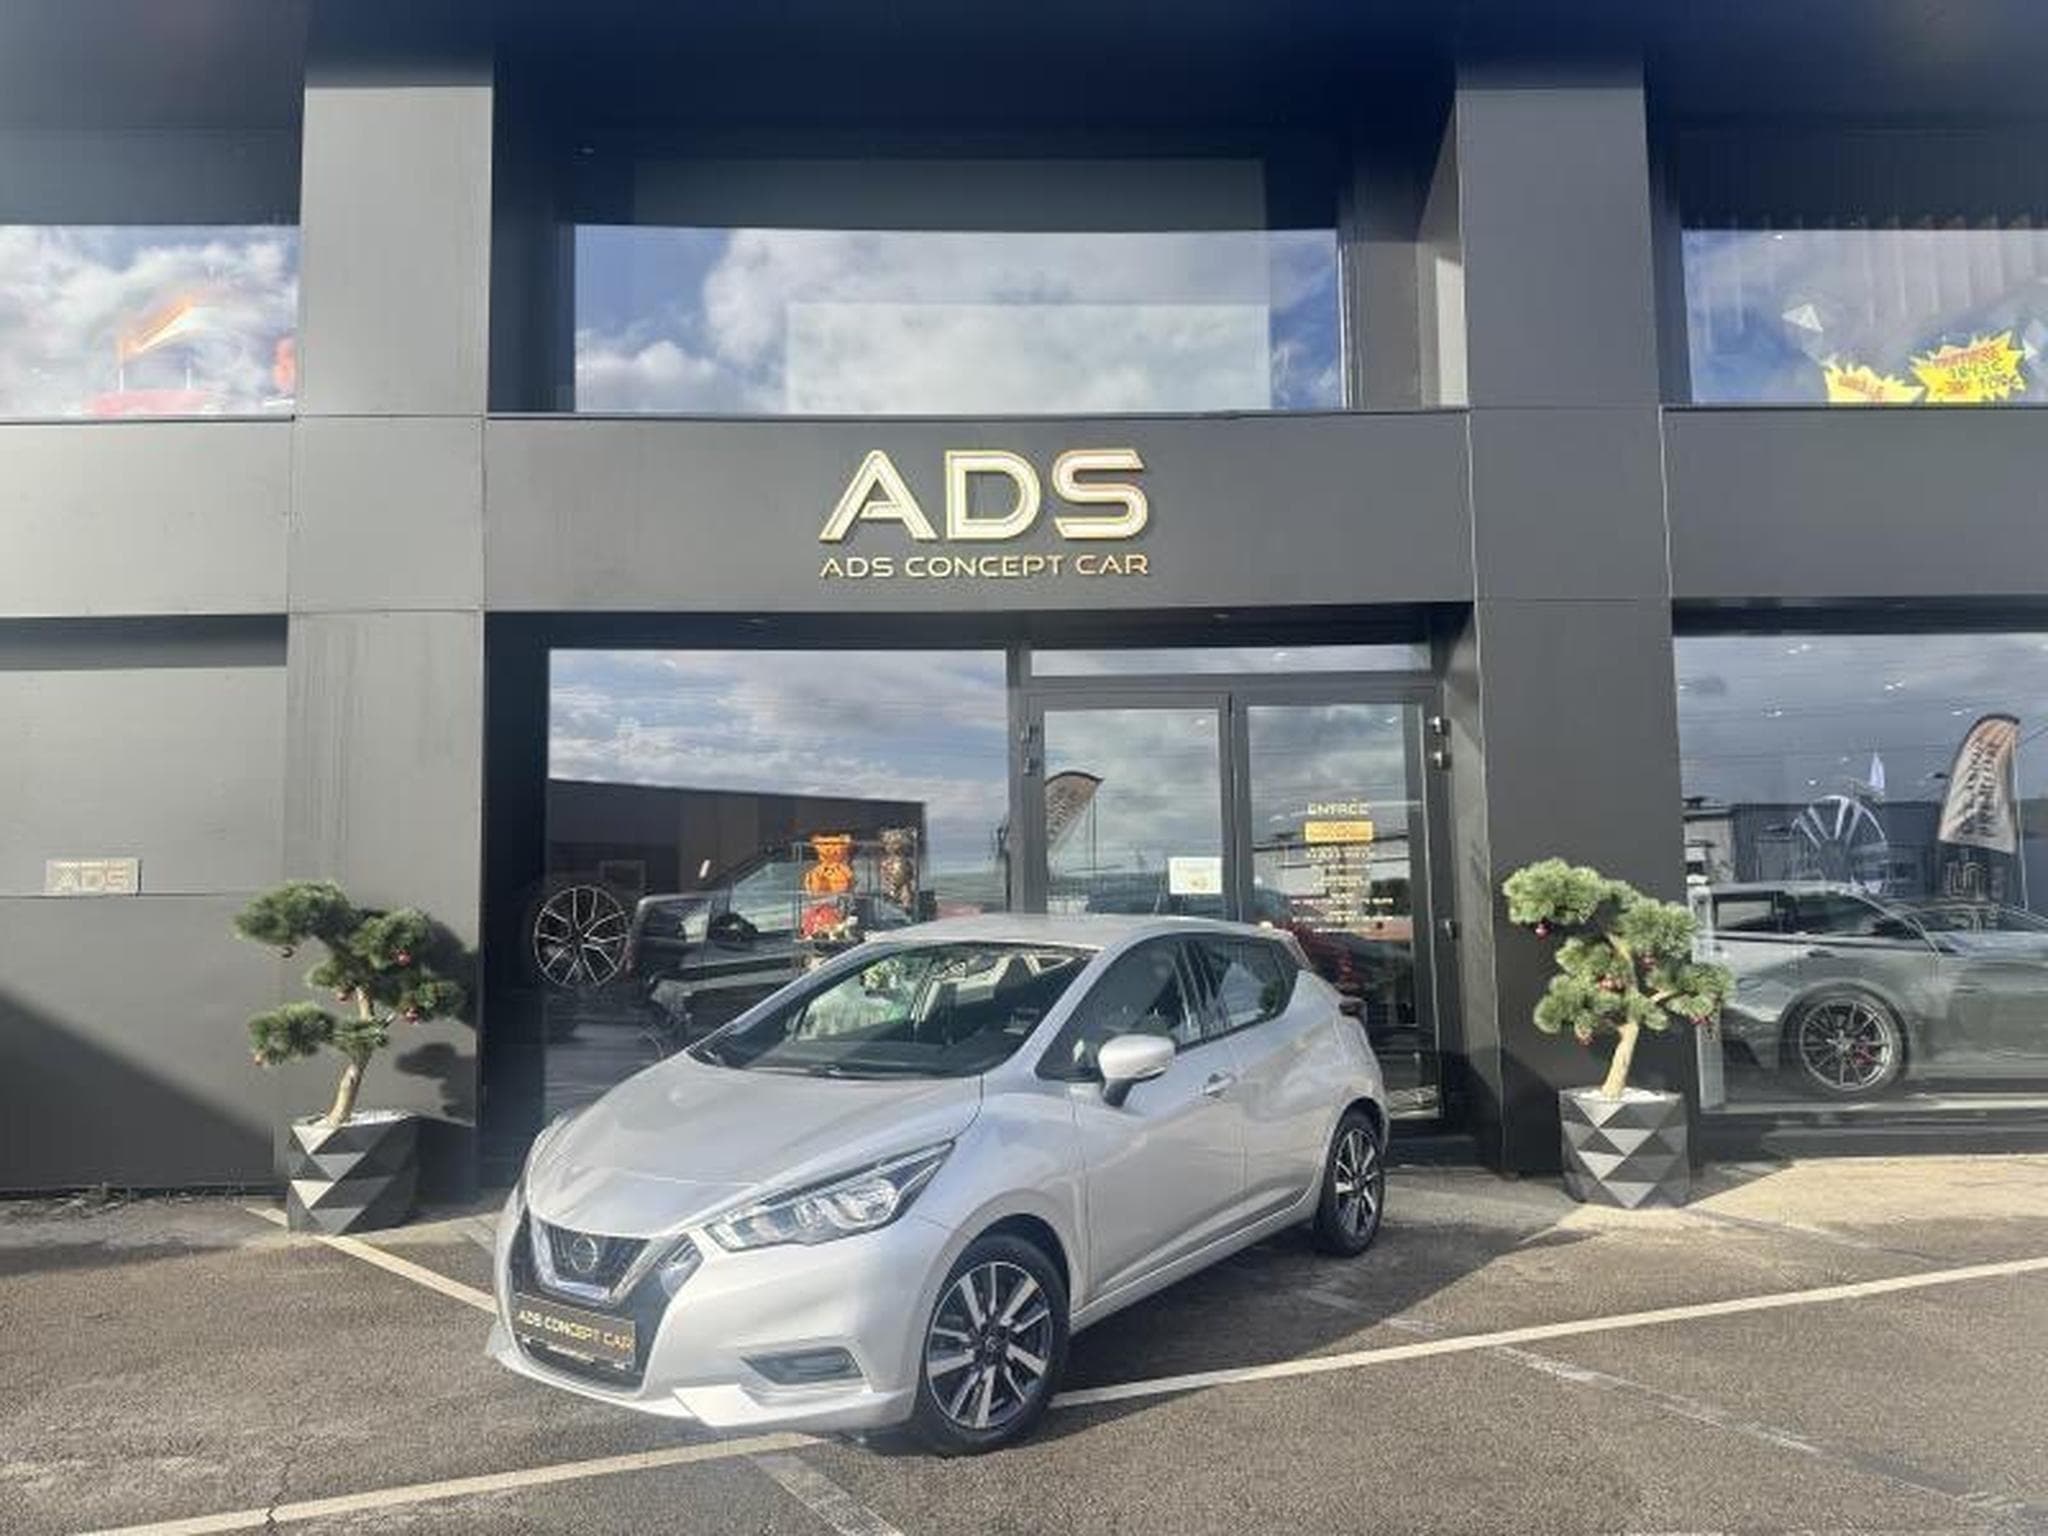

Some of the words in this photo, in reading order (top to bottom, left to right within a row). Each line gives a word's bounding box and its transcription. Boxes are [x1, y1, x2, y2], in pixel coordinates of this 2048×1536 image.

[818, 448, 1148, 541] ADS
[819, 555, 894, 579] ADS
[905, 554, 1063, 579] CONCEPT
[1075, 553, 1149, 576] CAR
[518, 1310, 541, 1328] ADS
[544, 1315, 600, 1342] CONCEPT
[603, 1331, 634, 1351] CAR
